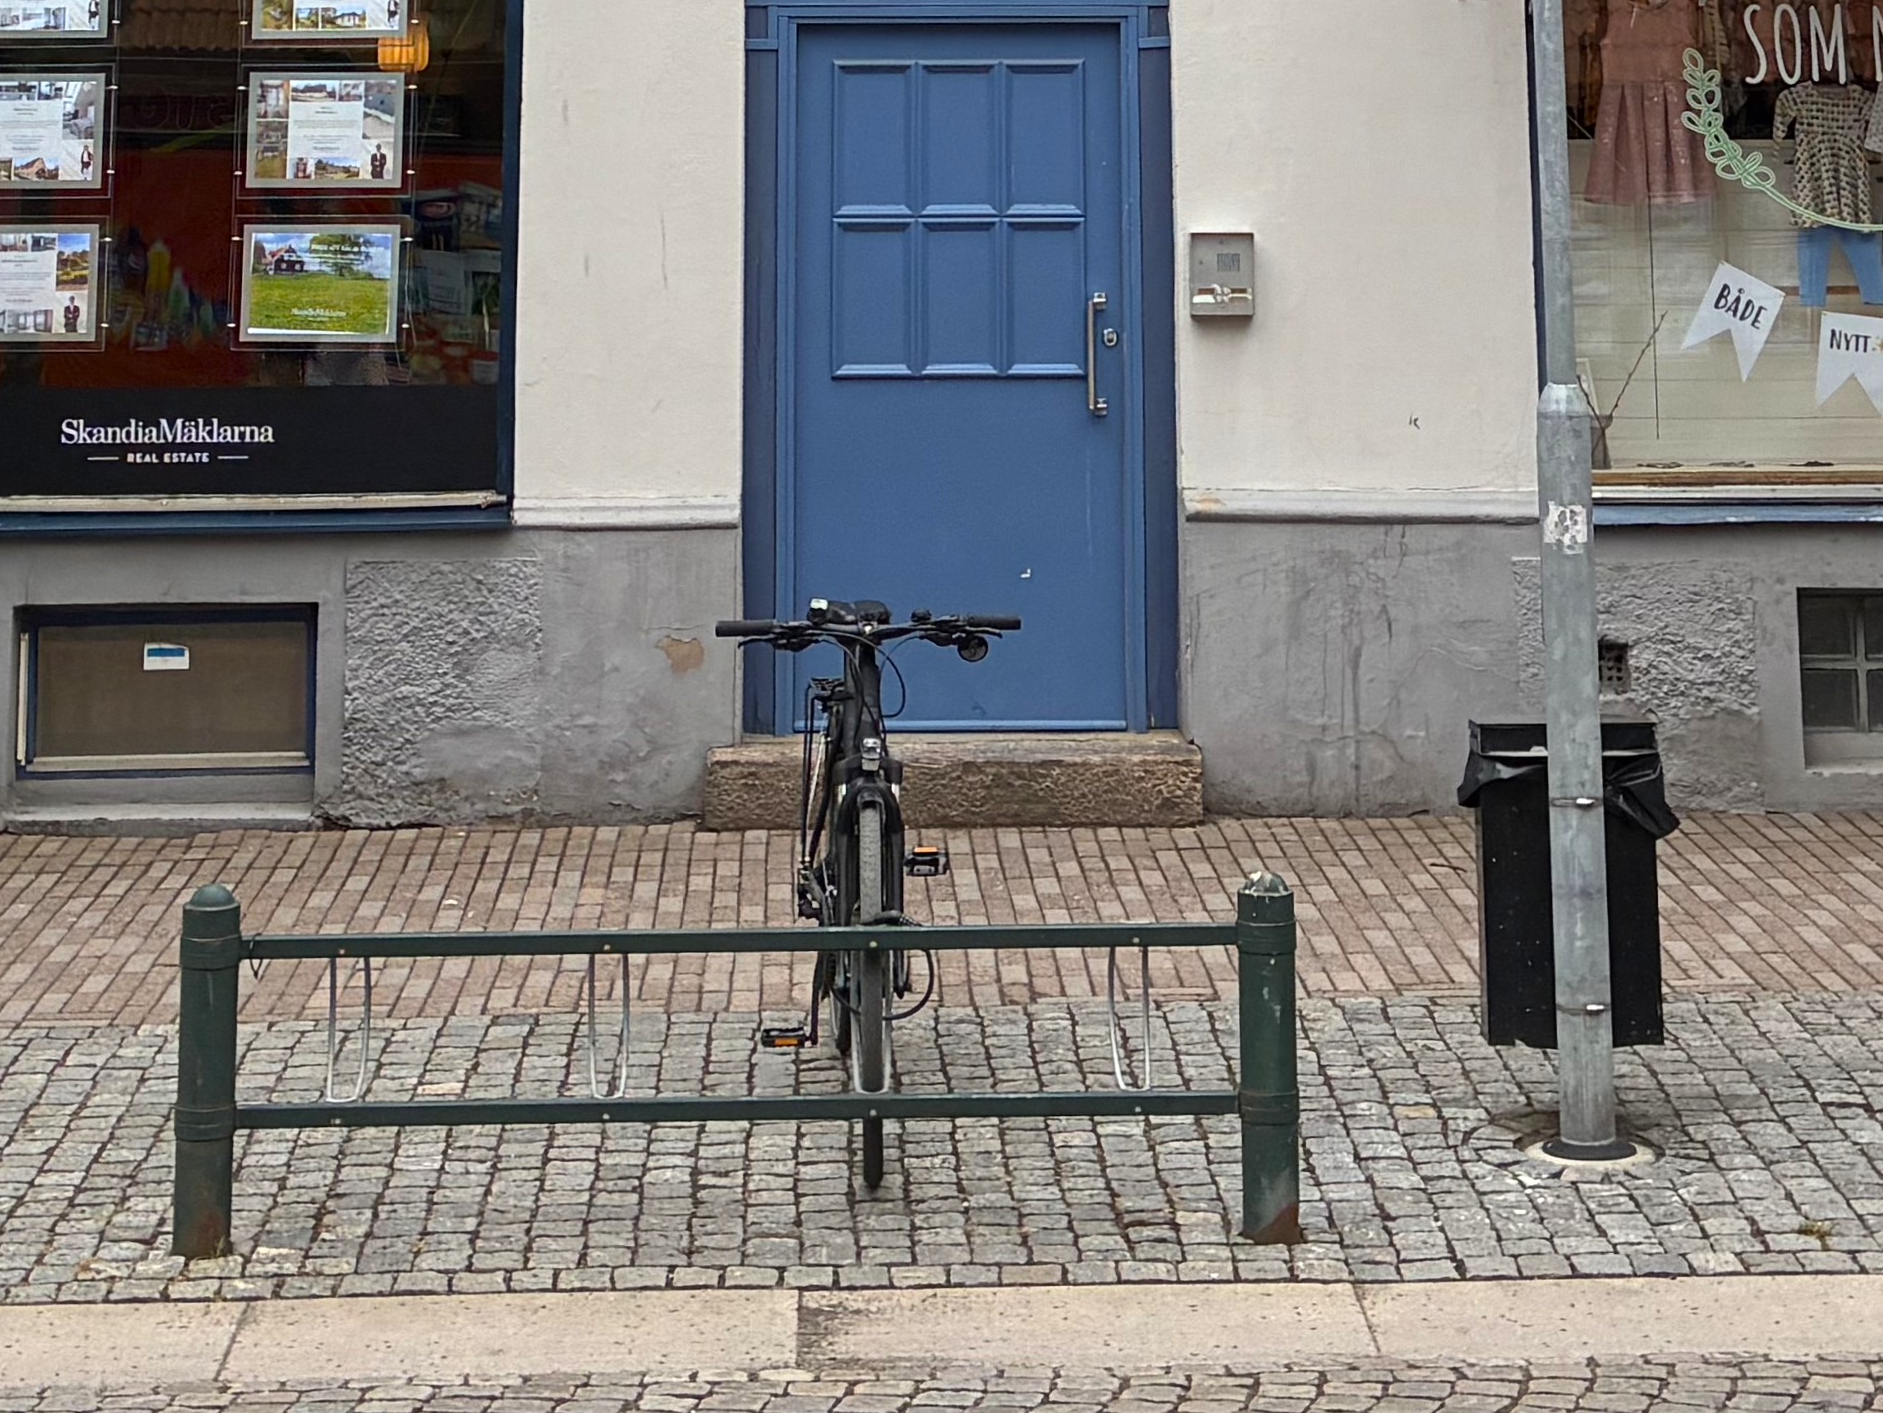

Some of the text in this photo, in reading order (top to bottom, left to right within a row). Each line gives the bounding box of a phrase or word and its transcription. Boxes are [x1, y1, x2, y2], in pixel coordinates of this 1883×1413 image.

[1743, 3, 1847, 85] SOM
[1713, 283, 1769, 330] BÅDE
[1829, 328, 1872, 354] NYTT
[60, 418, 275, 445] SkandiaMäklarna
[126, 452, 210, 464] REAL ESTATE
